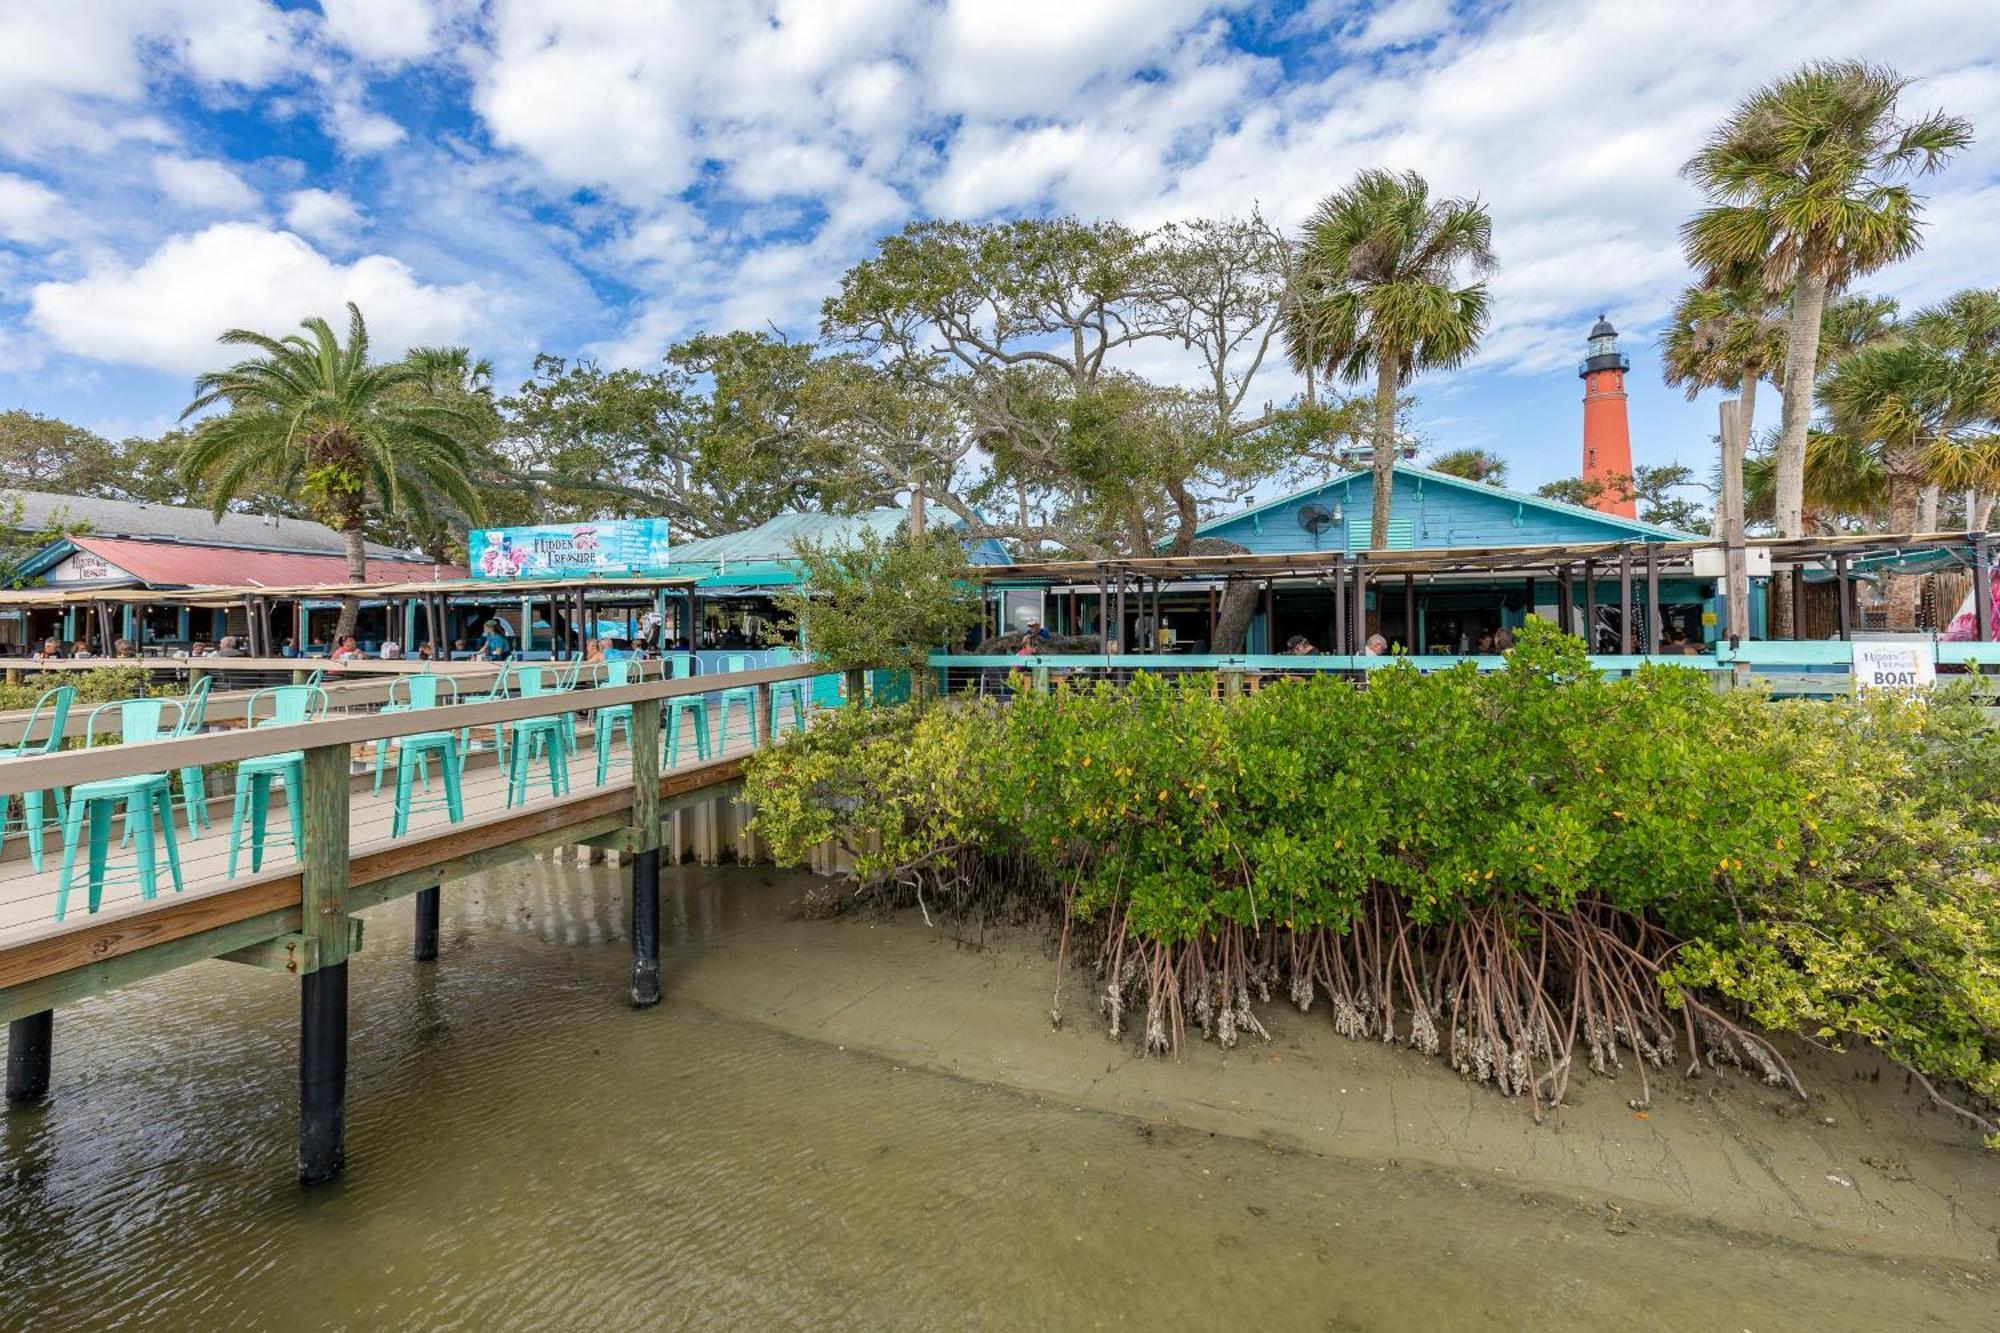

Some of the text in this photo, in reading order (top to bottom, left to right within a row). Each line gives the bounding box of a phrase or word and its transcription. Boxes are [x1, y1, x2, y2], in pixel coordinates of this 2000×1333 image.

[533, 538, 573, 553] HIDDEN
[546, 550, 596, 566] TREASURE
[1874, 672, 1916, 685] BOAT
